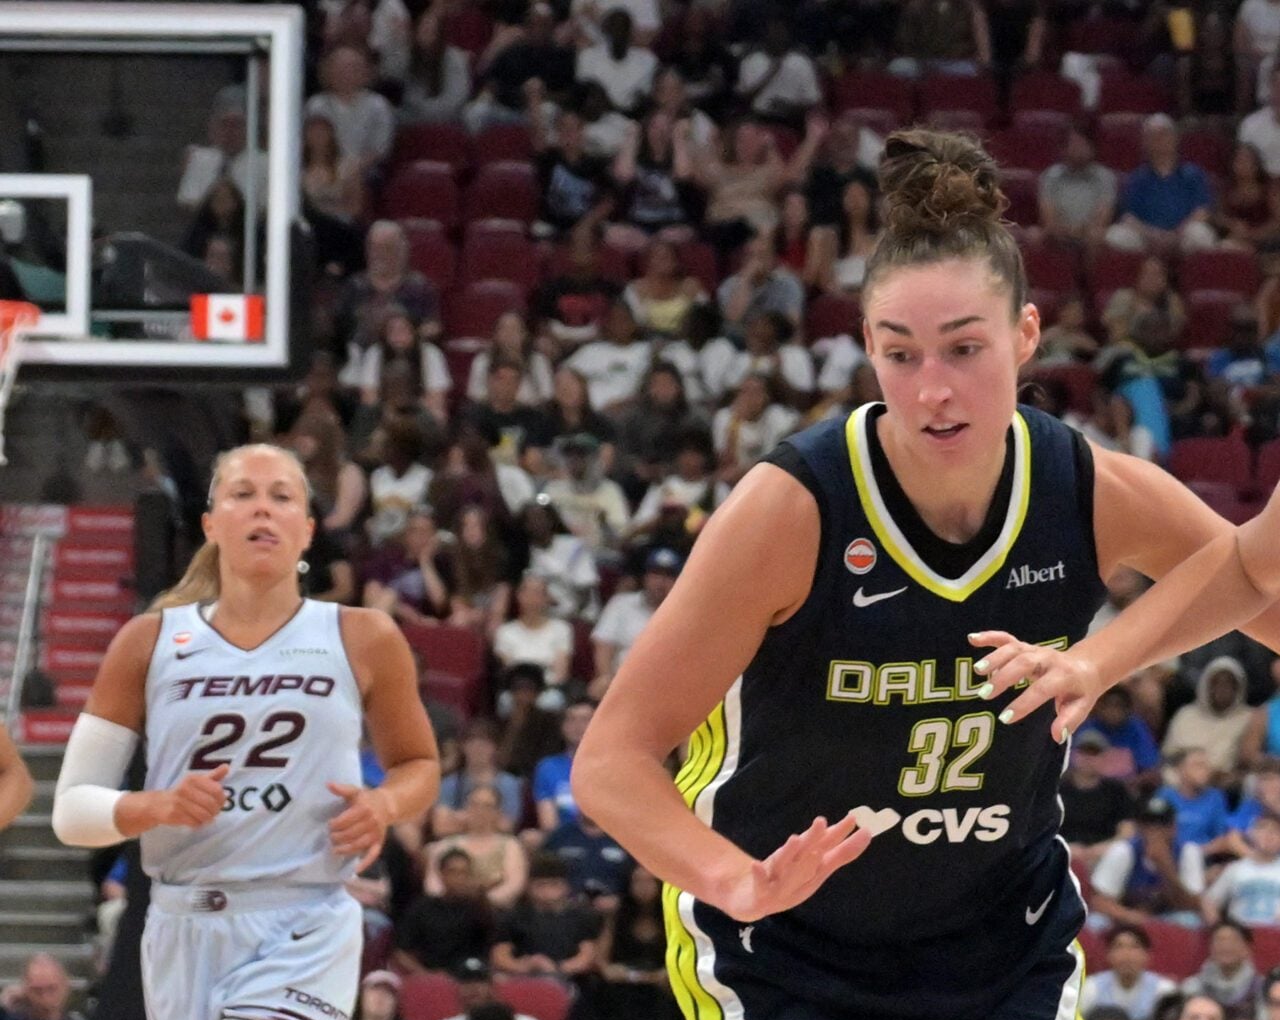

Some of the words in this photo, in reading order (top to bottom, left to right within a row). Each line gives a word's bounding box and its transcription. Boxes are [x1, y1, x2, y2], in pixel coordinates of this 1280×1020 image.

[1005, 560, 1066, 589] Albert
[166, 674, 336, 704] TEMPO
[826, 635, 1068, 705] DALL
[189, 711, 306, 771] 22
[897, 711, 996, 797] 32
[902, 804, 1011, 845] CVS
